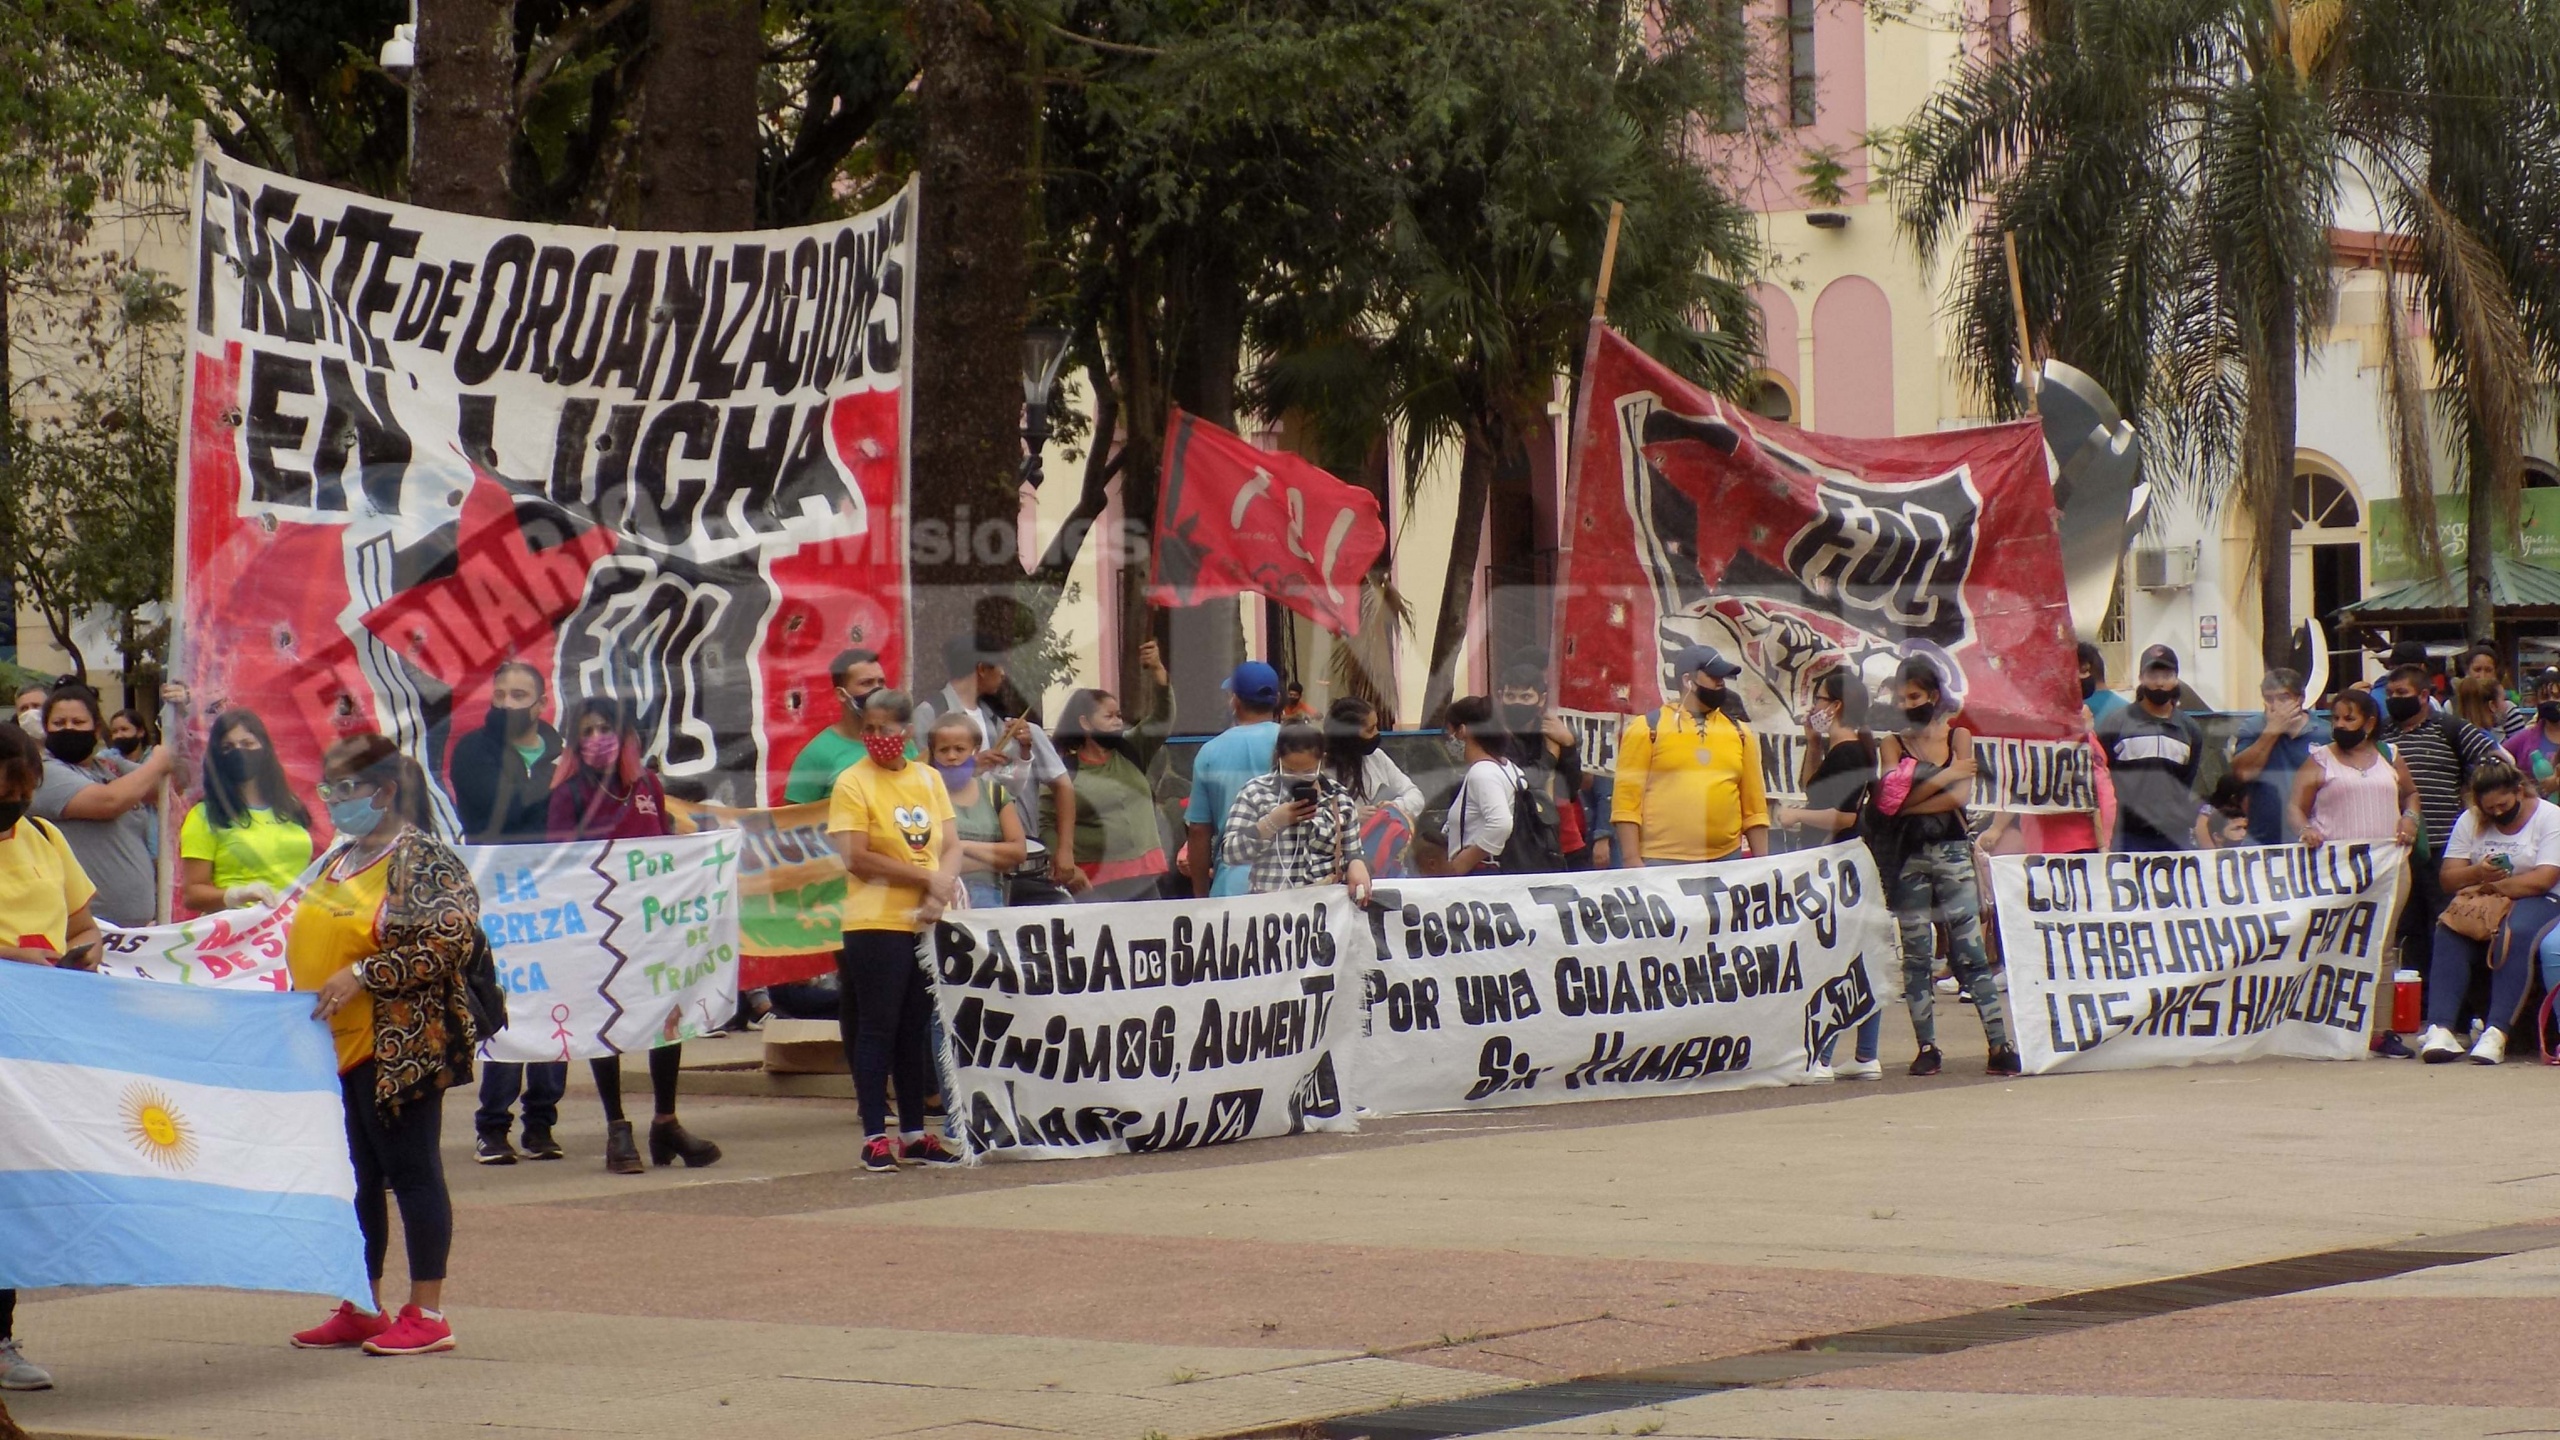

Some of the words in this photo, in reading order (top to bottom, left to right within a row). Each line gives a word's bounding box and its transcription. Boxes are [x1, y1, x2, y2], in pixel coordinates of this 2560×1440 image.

[393, 260, 475, 353] DE
[250, 349, 412, 516] EN
[458, 393, 858, 546] LUCHA
[2007, 743, 2100, 809] LUCH
[495, 868, 539, 904] LA
[482, 901, 587, 949] BREZA
[686, 926, 709, 948] DE
[1188, 973, 1335, 1072] AUMENT
[2045, 991, 2135, 1053] LOS
